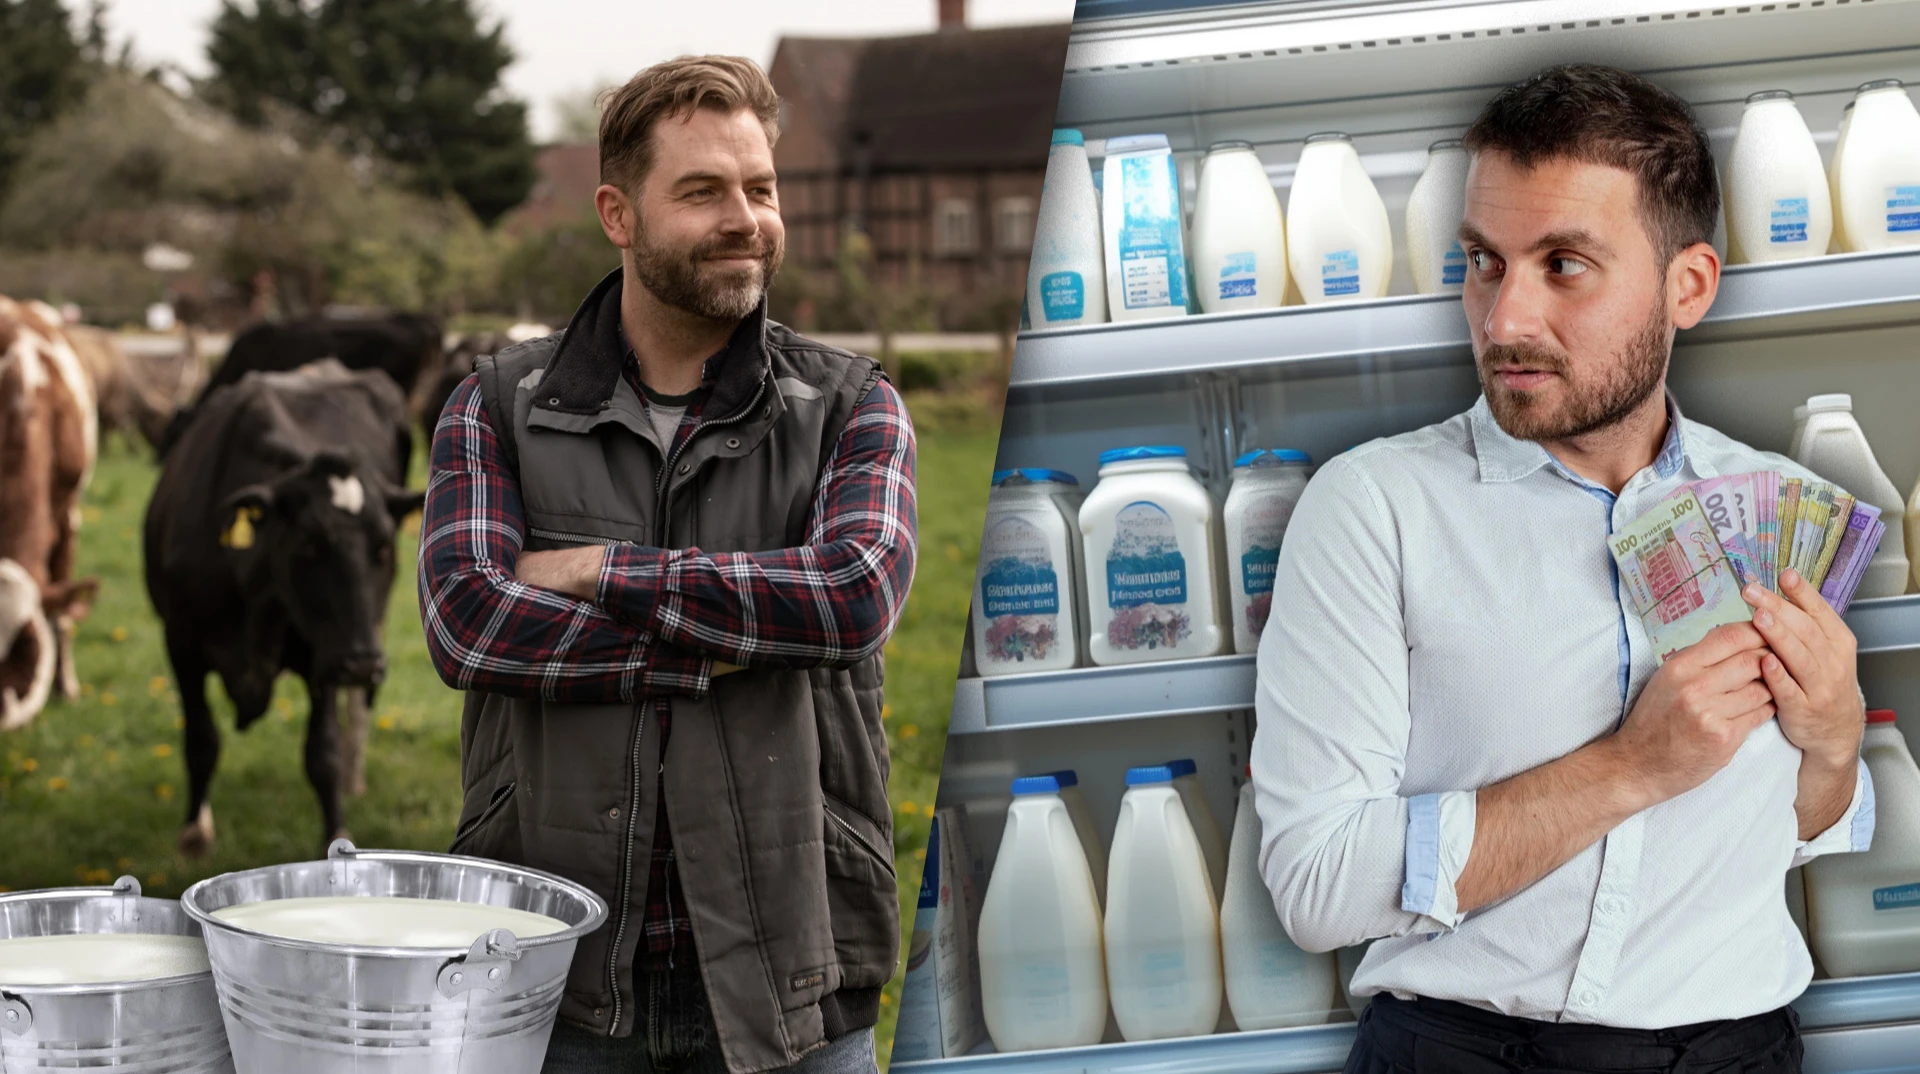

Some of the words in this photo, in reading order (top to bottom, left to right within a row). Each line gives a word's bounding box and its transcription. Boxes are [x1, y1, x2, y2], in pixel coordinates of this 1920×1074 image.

[1615, 534, 1638, 557] 100
[1640, 519, 1671, 542] ГРИВЕНЬ
[1671, 498, 1694, 520] 100
[1705, 493, 1732, 534] 200
[1852, 515, 1868, 528] 50
